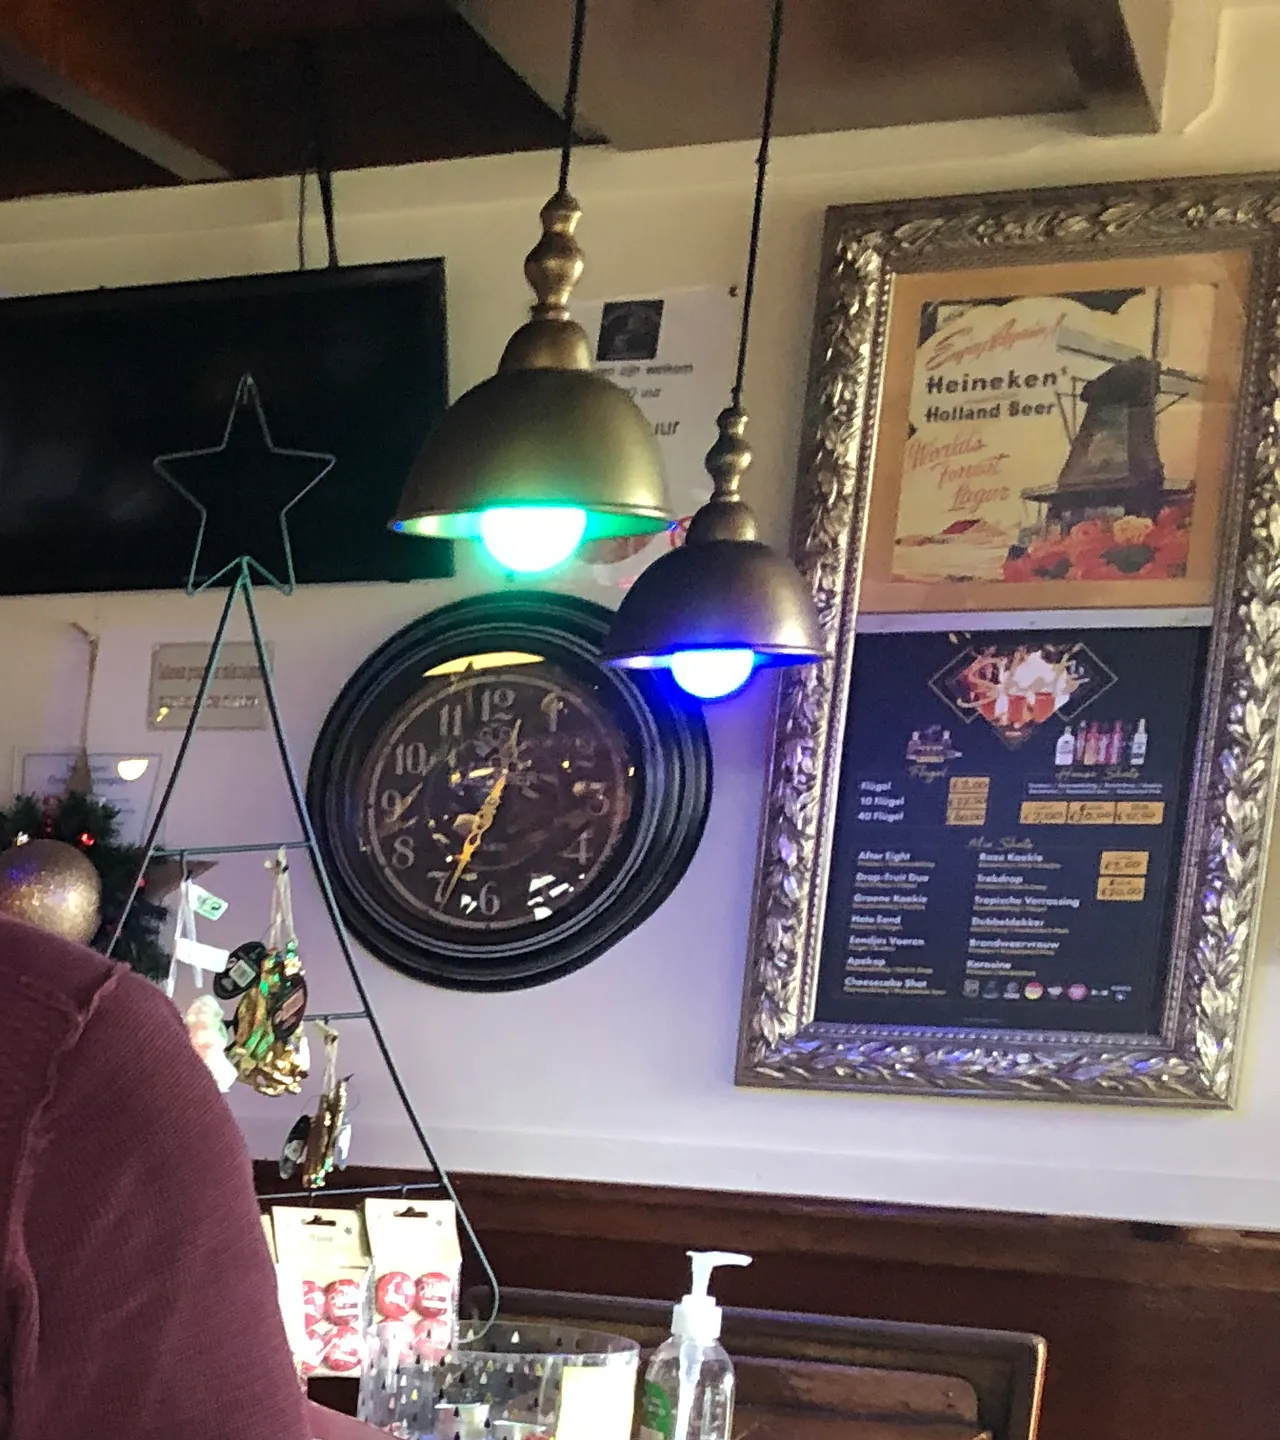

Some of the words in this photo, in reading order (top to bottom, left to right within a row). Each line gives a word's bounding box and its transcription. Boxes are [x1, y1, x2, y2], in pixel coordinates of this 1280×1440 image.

[925, 403, 1000, 423] Holland
[1007, 400, 1055, 417] Beer
[480, 688, 516, 721] 12
[394, 742, 429, 776] 10
[381, 789, 405, 822] 9
[391, 835, 416, 869] 8
[478, 880, 500, 917] 6
